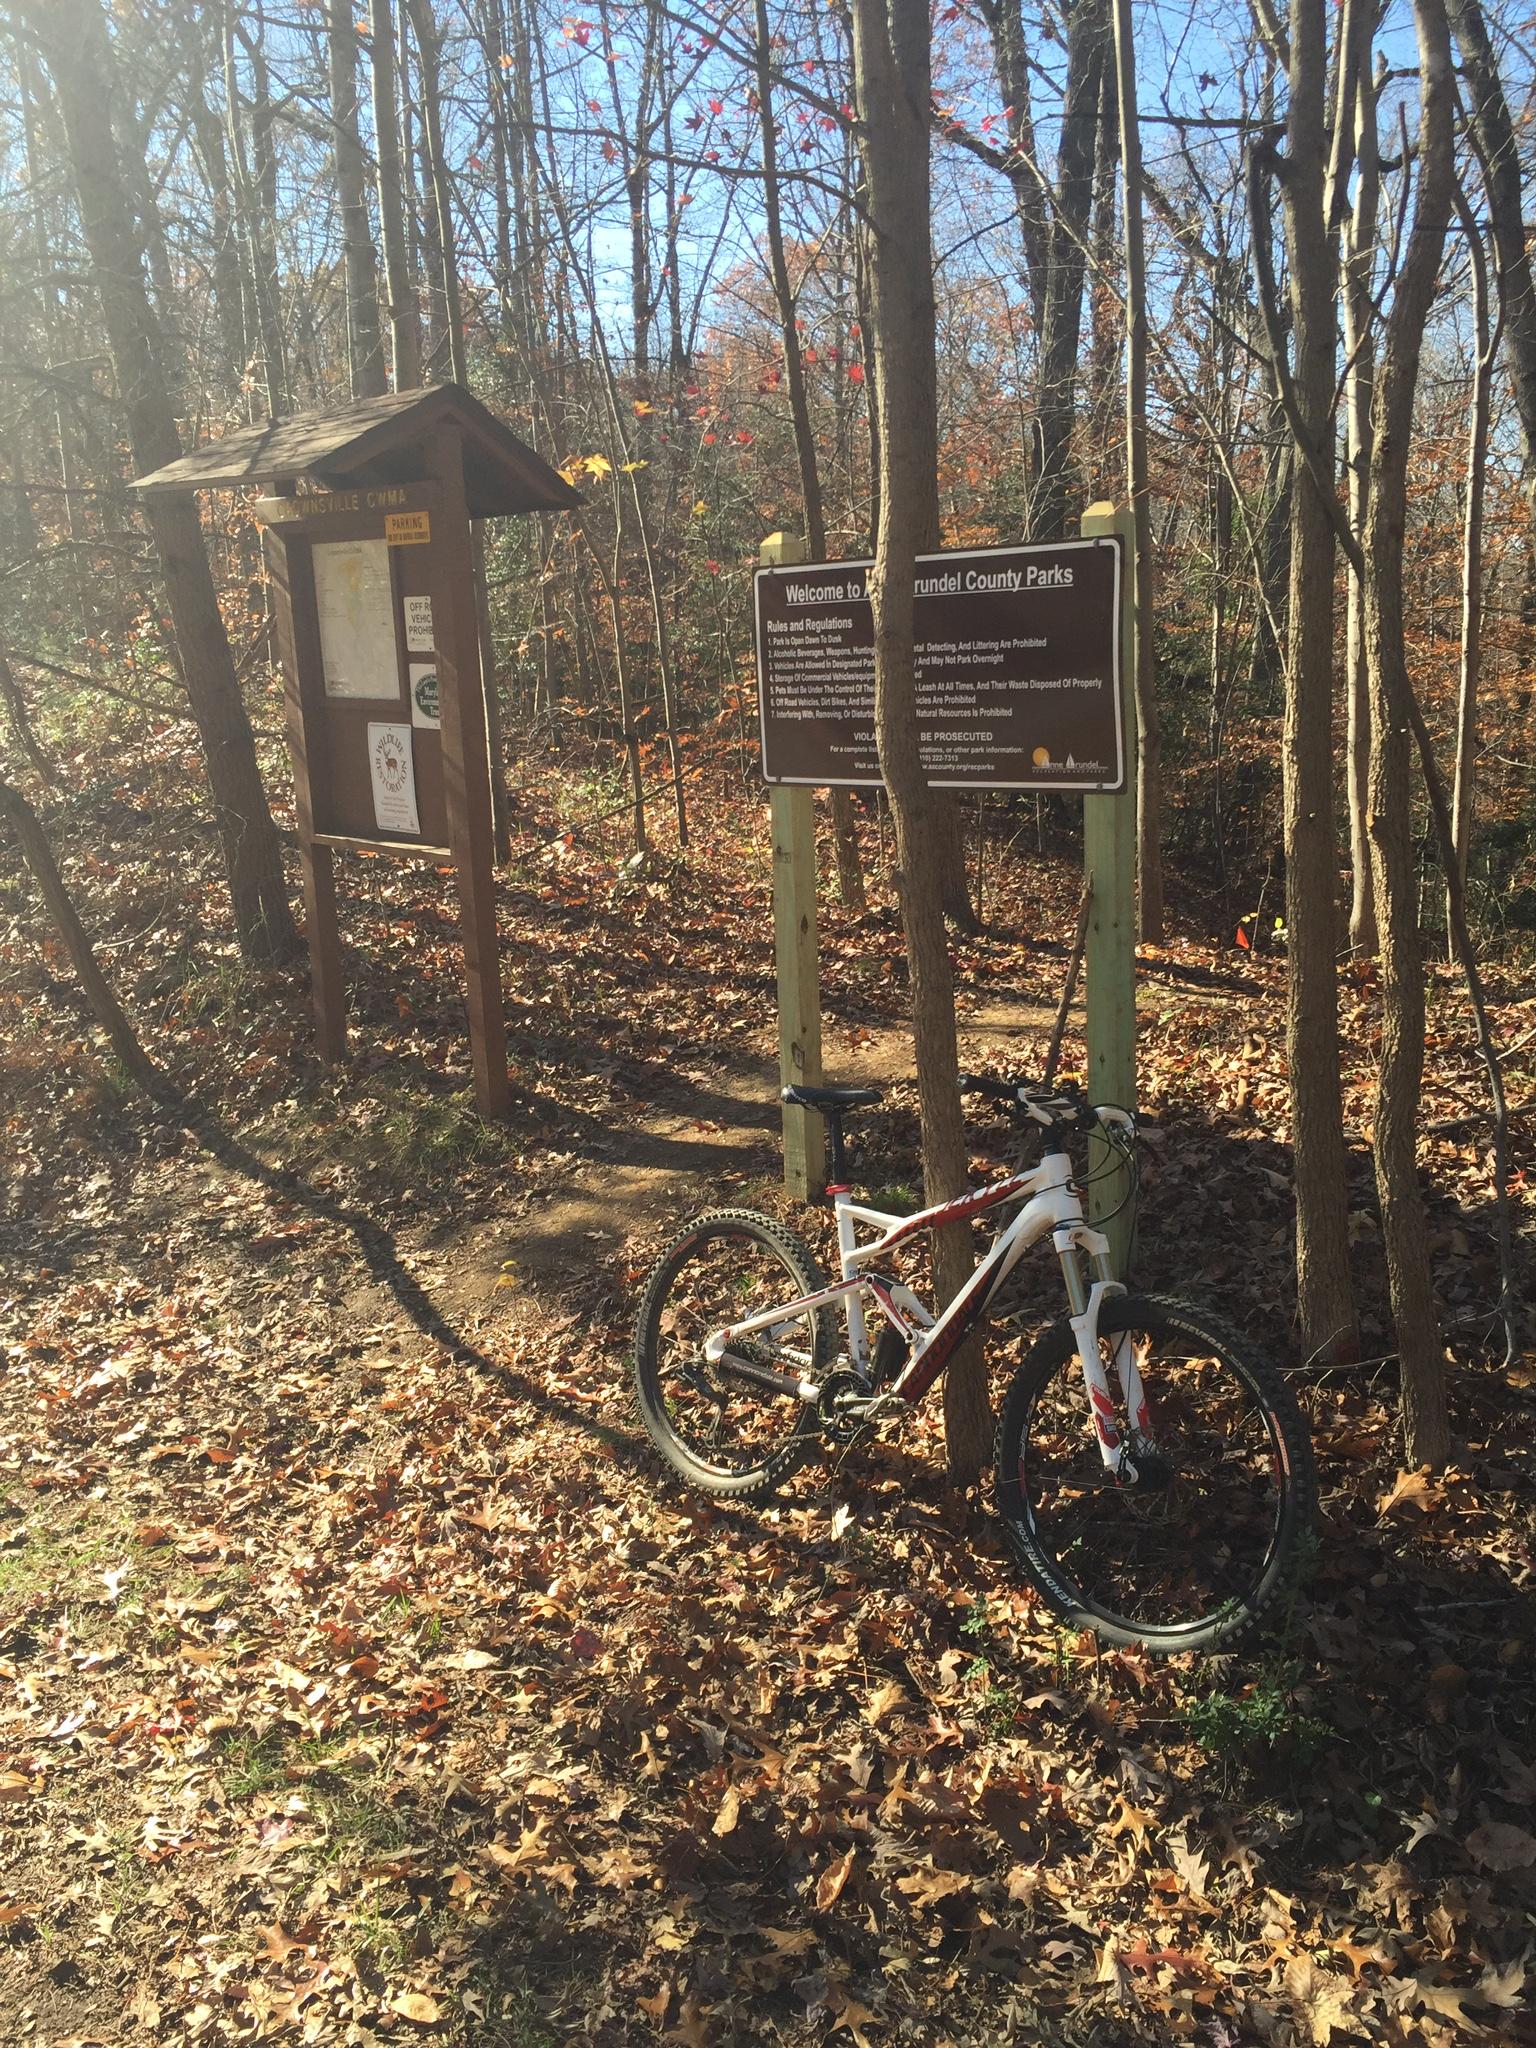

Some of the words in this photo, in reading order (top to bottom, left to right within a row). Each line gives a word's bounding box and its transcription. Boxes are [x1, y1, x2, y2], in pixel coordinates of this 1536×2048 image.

[366, 489, 408, 509] CWMA
[392, 516, 422, 530] PARKING
[785, 584, 844, 603] Welcome
[846, 581, 860, 598] to
[914, 572, 961, 594] rundel
[965, 569, 1022, 592] County
[1026, 564, 1074, 586] Parks
[410, 602, 422, 612] OFF
[411, 614, 432, 624] VEHIC
[767, 620, 788, 632] Rules
[789, 619, 804, 631] and
[805, 617, 853, 633] Regulations
[408, 626, 434, 635] PROHIB
[773, 637, 785, 646] Park
[790, 637, 804, 647] Open
[805, 636, 820, 644] Dawn
[820, 635, 827, 644] To
[828, 634, 842, 643] Dusk
[773, 649, 797, 658] Alcoholic
[797, 648, 825, 659] Beverages,
[826, 647, 852, 658] Weapons,
[927, 642, 957, 653] Detecting,
[958, 641, 972, 650] And
[972, 640, 999, 651] Littering
[1000, 640, 1012, 649] Are
[1012, 637, 1047, 648] Prohibited
[774, 662, 794, 670] Vehicles
[796, 661, 804, 669] Are
[805, 661, 825, 669] Allowed
[826, 660, 832, 668] In
[832, 659, 862, 670] Designated
[918, 657, 930, 666] And
[931, 656, 944, 667] May
[945, 655, 956, 664] Not
[957, 654, 971, 664] Park
[972, 653, 1004, 664] Overnight
[774, 674, 794, 684] Storage
[794, 674, 801, 682] Of
[802, 673, 832, 682] Commercial
[832, 672, 876, 682] Vehicles/equipm
[776, 686, 786, 694] Pets
[787, 686, 800, 694] Must
[800, 686, 807, 694] Be
[808, 685, 824, 694] Under
[824, 684, 834, 694] The
[834, 684, 855, 693] Control
[856, 684, 862, 692] Of
[864, 684, 875, 692] The
[918, 682, 936, 692] Leash
[938, 682, 944, 690] At
[946, 682, 954, 690] All
[955, 681, 976, 692] Times,
[976, 681, 990, 690] And
[990, 680, 1007, 690] Their
[1008, 680, 1028, 690] Waste
[1030, 679, 1062, 690] Disposed
[1062, 678, 1072, 688] Of
[1072, 678, 1102, 689] Properly
[776, 698, 784, 706] Off
[784, 698, 797, 706] Road
[798, 698, 820, 707] Vehicles,
[821, 697, 830, 706] Dirt
[832, 697, 848, 706] Bikes,
[848, 697, 860, 705] And
[916, 696, 932, 704] icles
[932, 696, 944, 704] Are
[944, 694, 976, 704] Prohibited
[776, 710, 802, 720] Interfering
[816, 710, 842, 720] Removing,
[844, 710, 850, 718] Or
[916, 708, 938, 718] Natural
[938, 708, 972, 718] Resources
[972, 708, 978, 717] Is
[980, 707, 1013, 717] Prohibited
[854, 732, 878, 741] VIOLA
[920, 732, 932, 741] BE
[934, 732, 993, 742] PROSECUTED
[376, 734, 404, 754] WILDLIFE
[844, 746, 868, 754] complete
[919, 746, 944, 754] ulations,
[970, 746, 984, 754] park
[986, 746, 1024, 754] information:
[1016, 1520, 1077, 1607] KENDATIRE.COM
